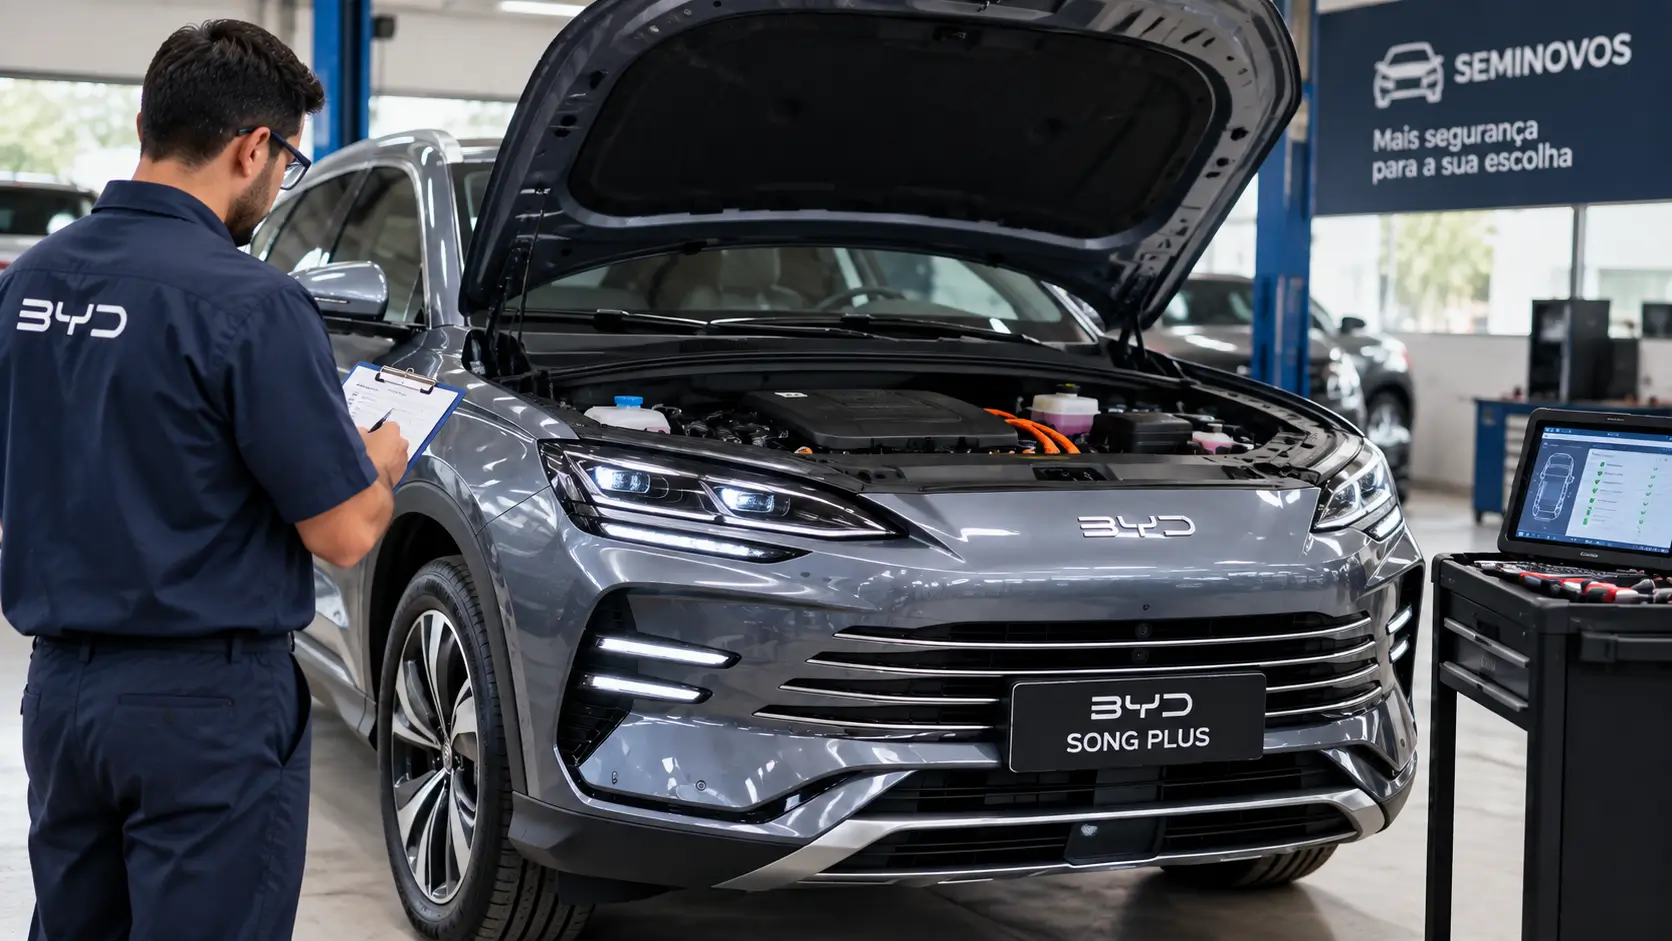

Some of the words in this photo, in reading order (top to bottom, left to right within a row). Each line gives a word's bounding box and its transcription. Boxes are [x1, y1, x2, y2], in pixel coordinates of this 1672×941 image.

[1454, 33, 1632, 84] SEMINOVOS
[1373, 126, 1419, 152] Mais
[1424, 120, 1539, 152] segurança
[1372, 157, 1418, 184] para
[1422, 157, 1436, 176] a
[1441, 156, 1479, 175] sua
[1485, 143, 1573, 172] escolha
[16, 298, 128, 339] BYD
[1077, 515, 1196, 538] BYD
[1090, 693, 1193, 720] BYD
[1066, 731, 1139, 753] SONG
[1147, 727, 1210, 749] PLUS
